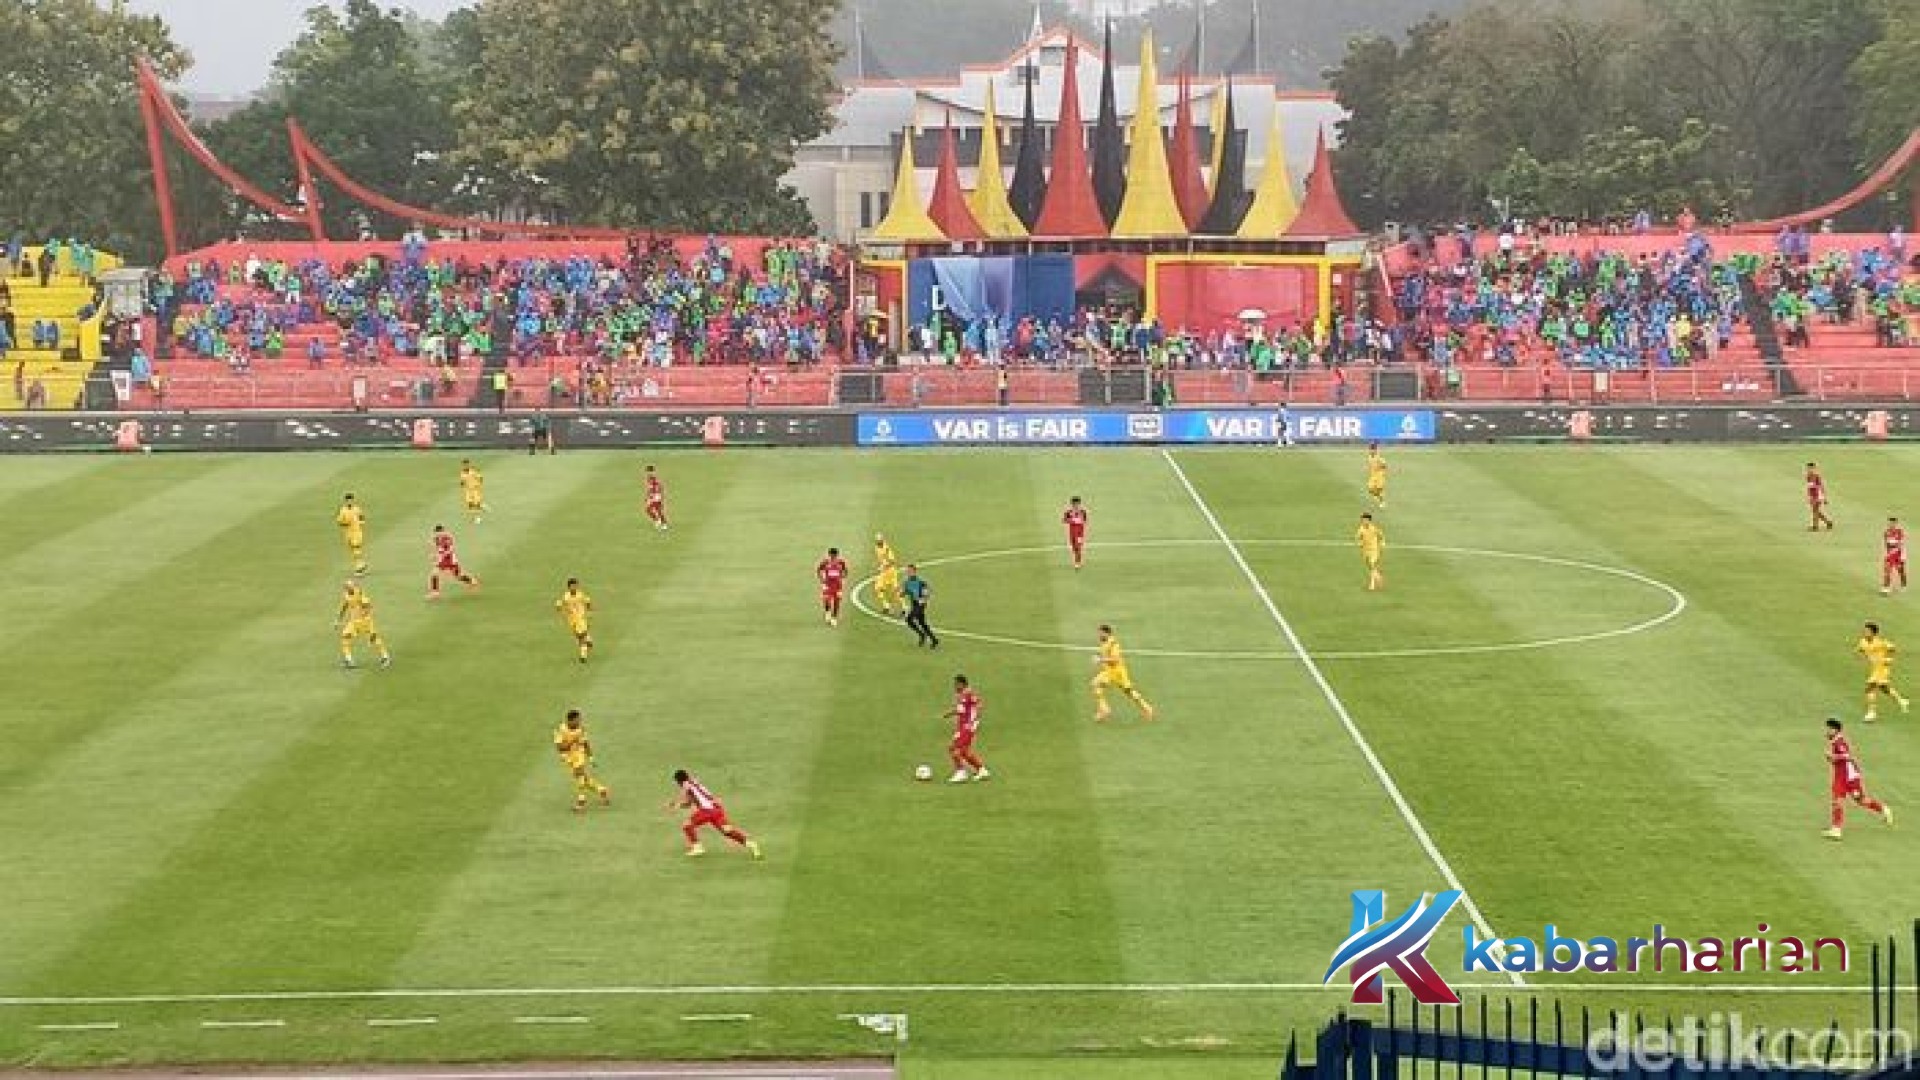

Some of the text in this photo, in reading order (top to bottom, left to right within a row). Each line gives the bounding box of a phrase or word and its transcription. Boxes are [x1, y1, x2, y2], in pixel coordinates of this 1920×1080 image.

[932, 416, 1088, 440] VAR is FAIR
[1206, 417, 1262, 437] VAR
[1300, 417, 1361, 437] FAIR
